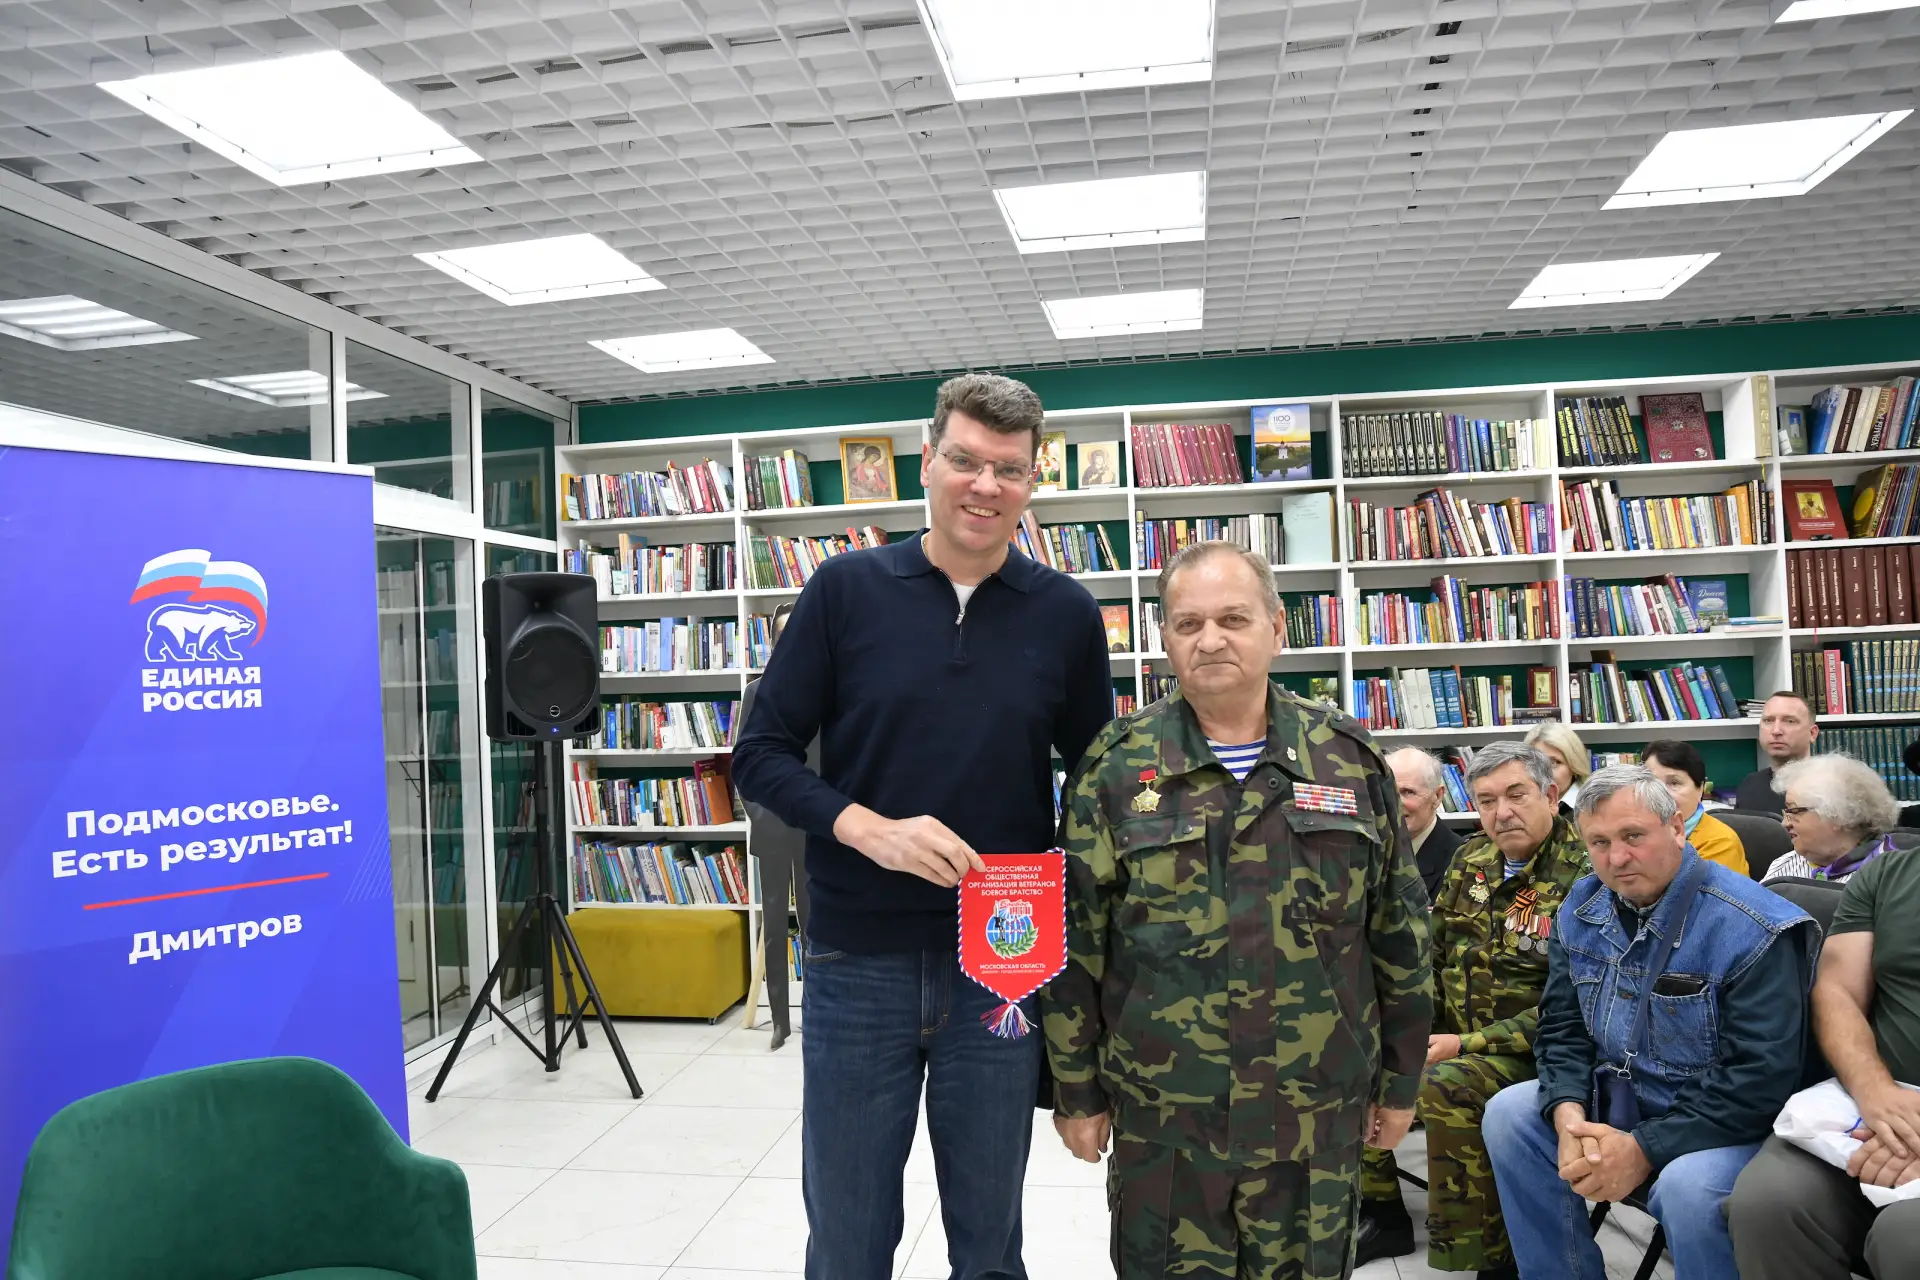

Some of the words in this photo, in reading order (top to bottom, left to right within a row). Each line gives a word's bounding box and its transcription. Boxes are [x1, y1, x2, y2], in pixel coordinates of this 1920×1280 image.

[1871, 421, 1883, 447] ХРАМЫ
[141, 665, 261, 688] ЕДИНАЯ
[142, 688, 262, 712] РОССИЯ
[66, 792, 339, 838] Подмосковье.
[52, 845, 148, 879] Есть
[160, 820, 353, 871] результат!
[128, 912, 303, 965] Дмитров
